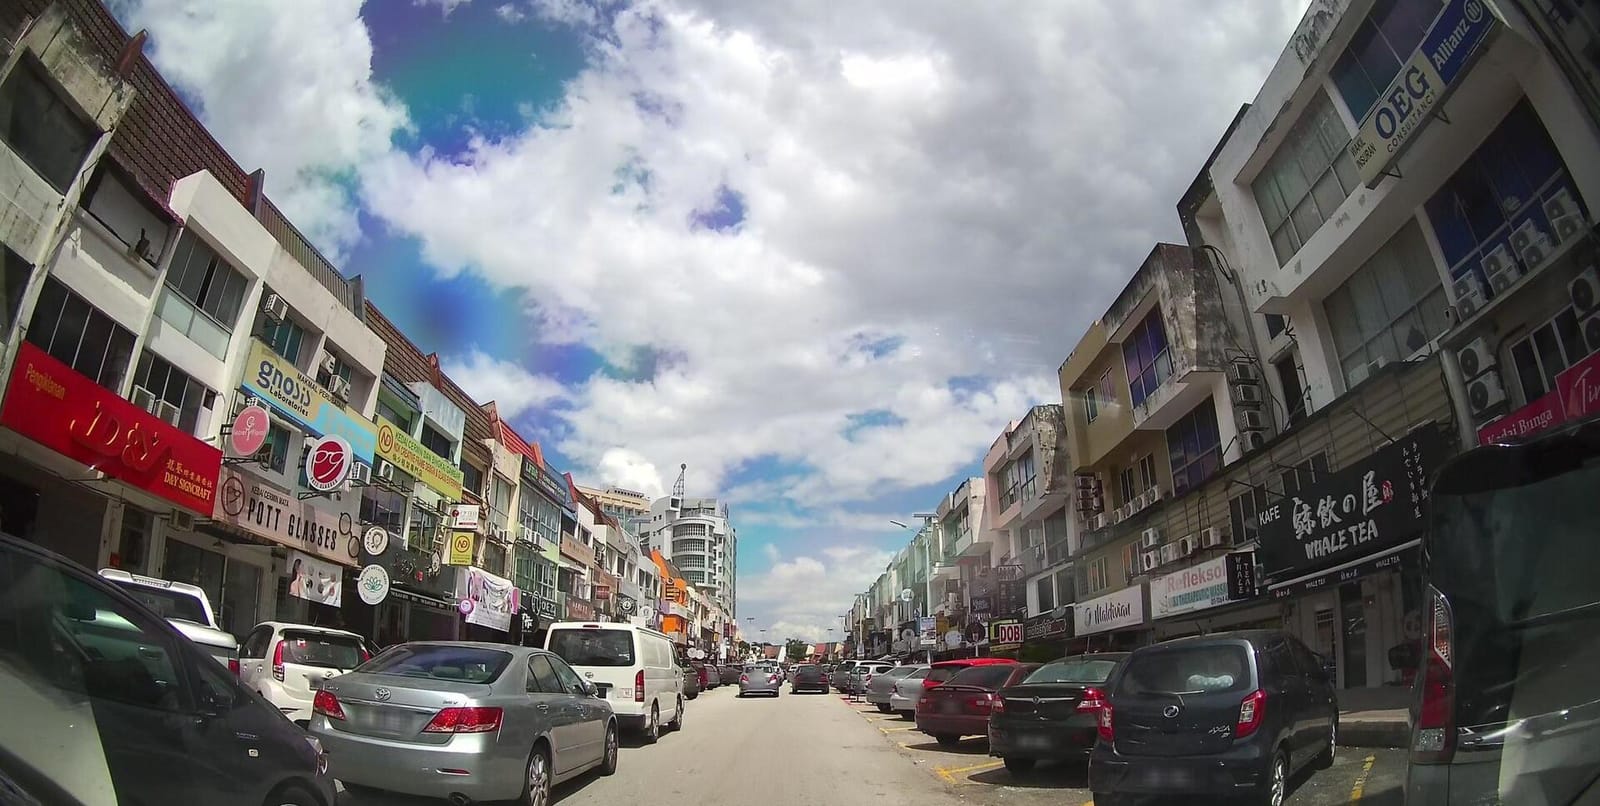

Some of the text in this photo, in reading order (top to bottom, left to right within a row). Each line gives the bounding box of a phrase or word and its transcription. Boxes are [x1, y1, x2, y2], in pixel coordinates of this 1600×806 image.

[1432, 19, 1471, 71] Allianz
[1375, 65, 1432, 140] OEG
[1386, 89, 1437, 153] CONSULTANCY
[256, 360, 312, 407] gnosis
[269, 386, 309, 418] Laboratories
[1519, 409, 1553, 436] Bunga
[178, 478, 212, 501] SIGNCRAFT
[251, 485, 264, 498] KEDAI
[248, 498, 281, 532] POTT
[288, 514, 338, 551] GLASSES
[1259, 505, 1282, 526] KAFE
[1304, 519, 1379, 560] WHALE TEA
[1235, 556, 1251, 594] WHALE TEA
[1094, 602, 1131, 625] Maldivian
[1000, 625, 1023, 642] DOBI
